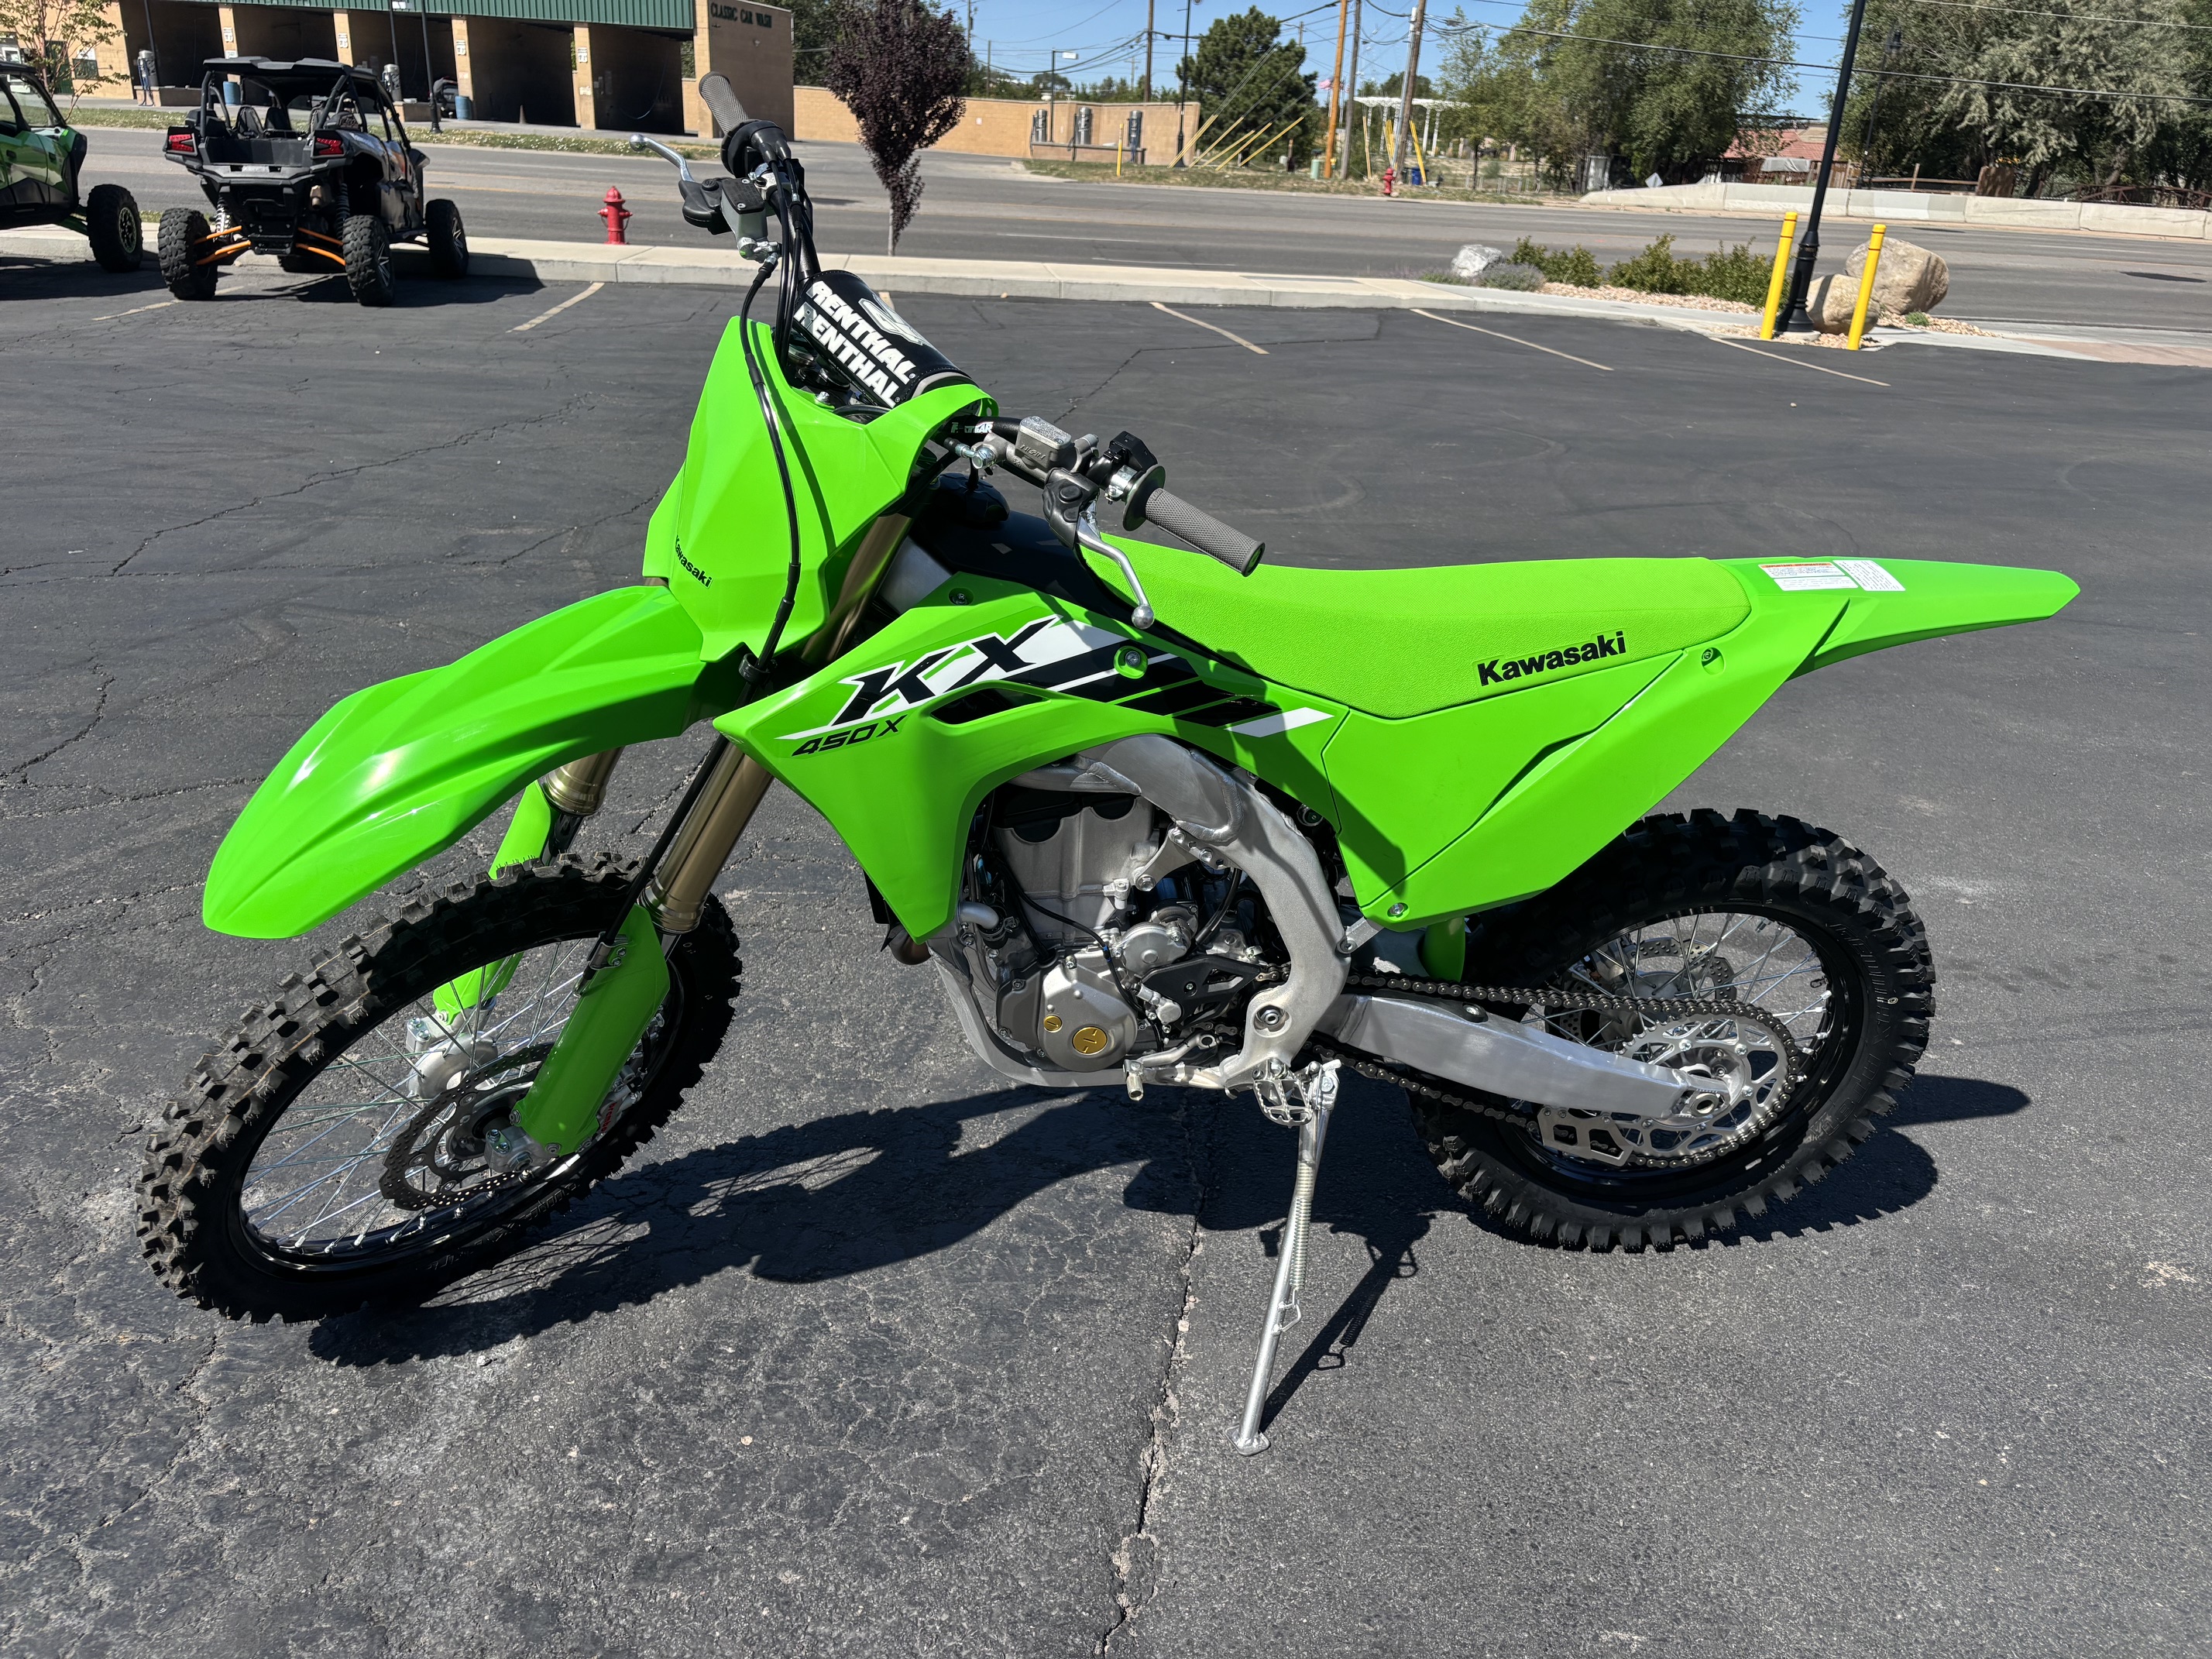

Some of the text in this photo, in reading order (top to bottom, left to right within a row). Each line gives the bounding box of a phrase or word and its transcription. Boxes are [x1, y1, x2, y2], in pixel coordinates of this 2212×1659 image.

[710, 2, 737, 22] CLASSIC
[740, 9, 754, 25] CAR
[793, 302, 899, 409] RENTHAL
[806, 280, 916, 385] RENTHAL
[831, 617, 1057, 726] KX
[1477, 630, 1626, 687] Kawasaki
